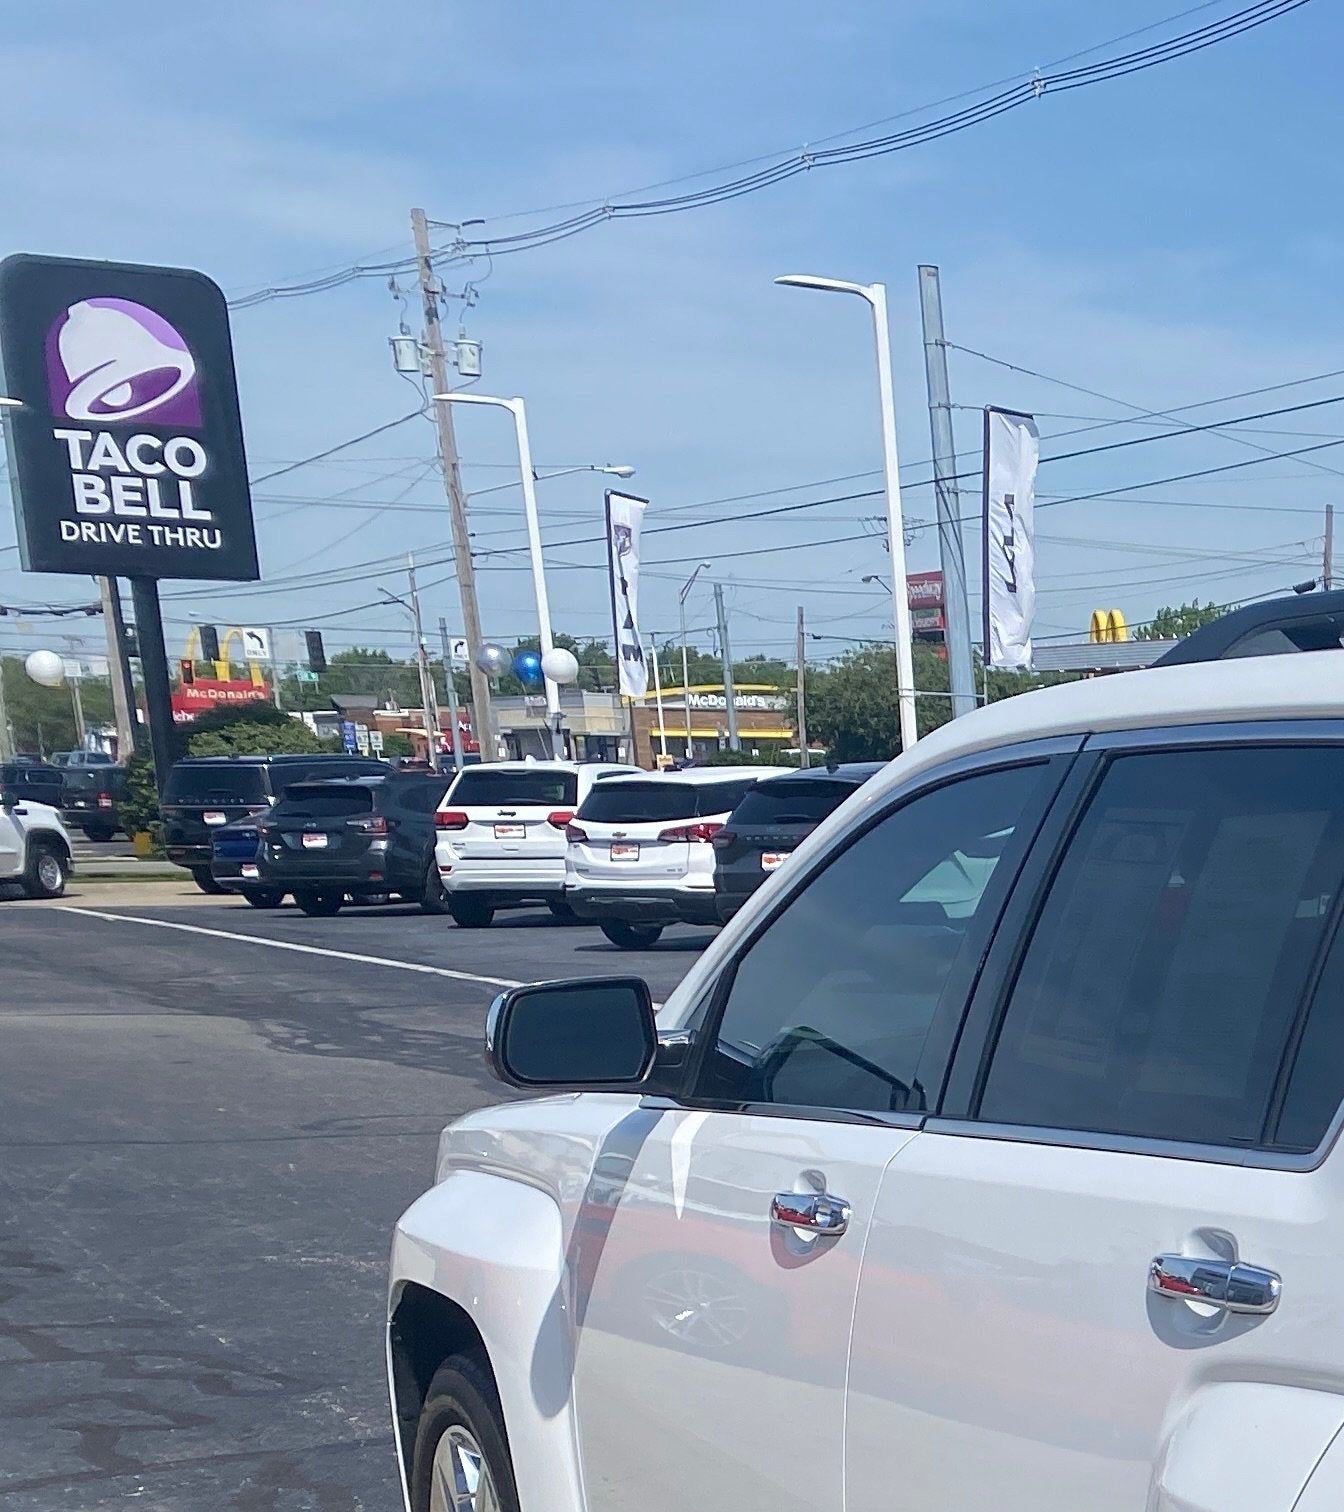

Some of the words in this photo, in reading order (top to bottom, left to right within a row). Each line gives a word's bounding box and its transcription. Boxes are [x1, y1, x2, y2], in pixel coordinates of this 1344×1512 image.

[53, 428, 208, 478] TACO
[71, 473, 213, 521] BELL
[59, 520, 143, 544] DRIVE
[147, 525, 222, 549] THRU
